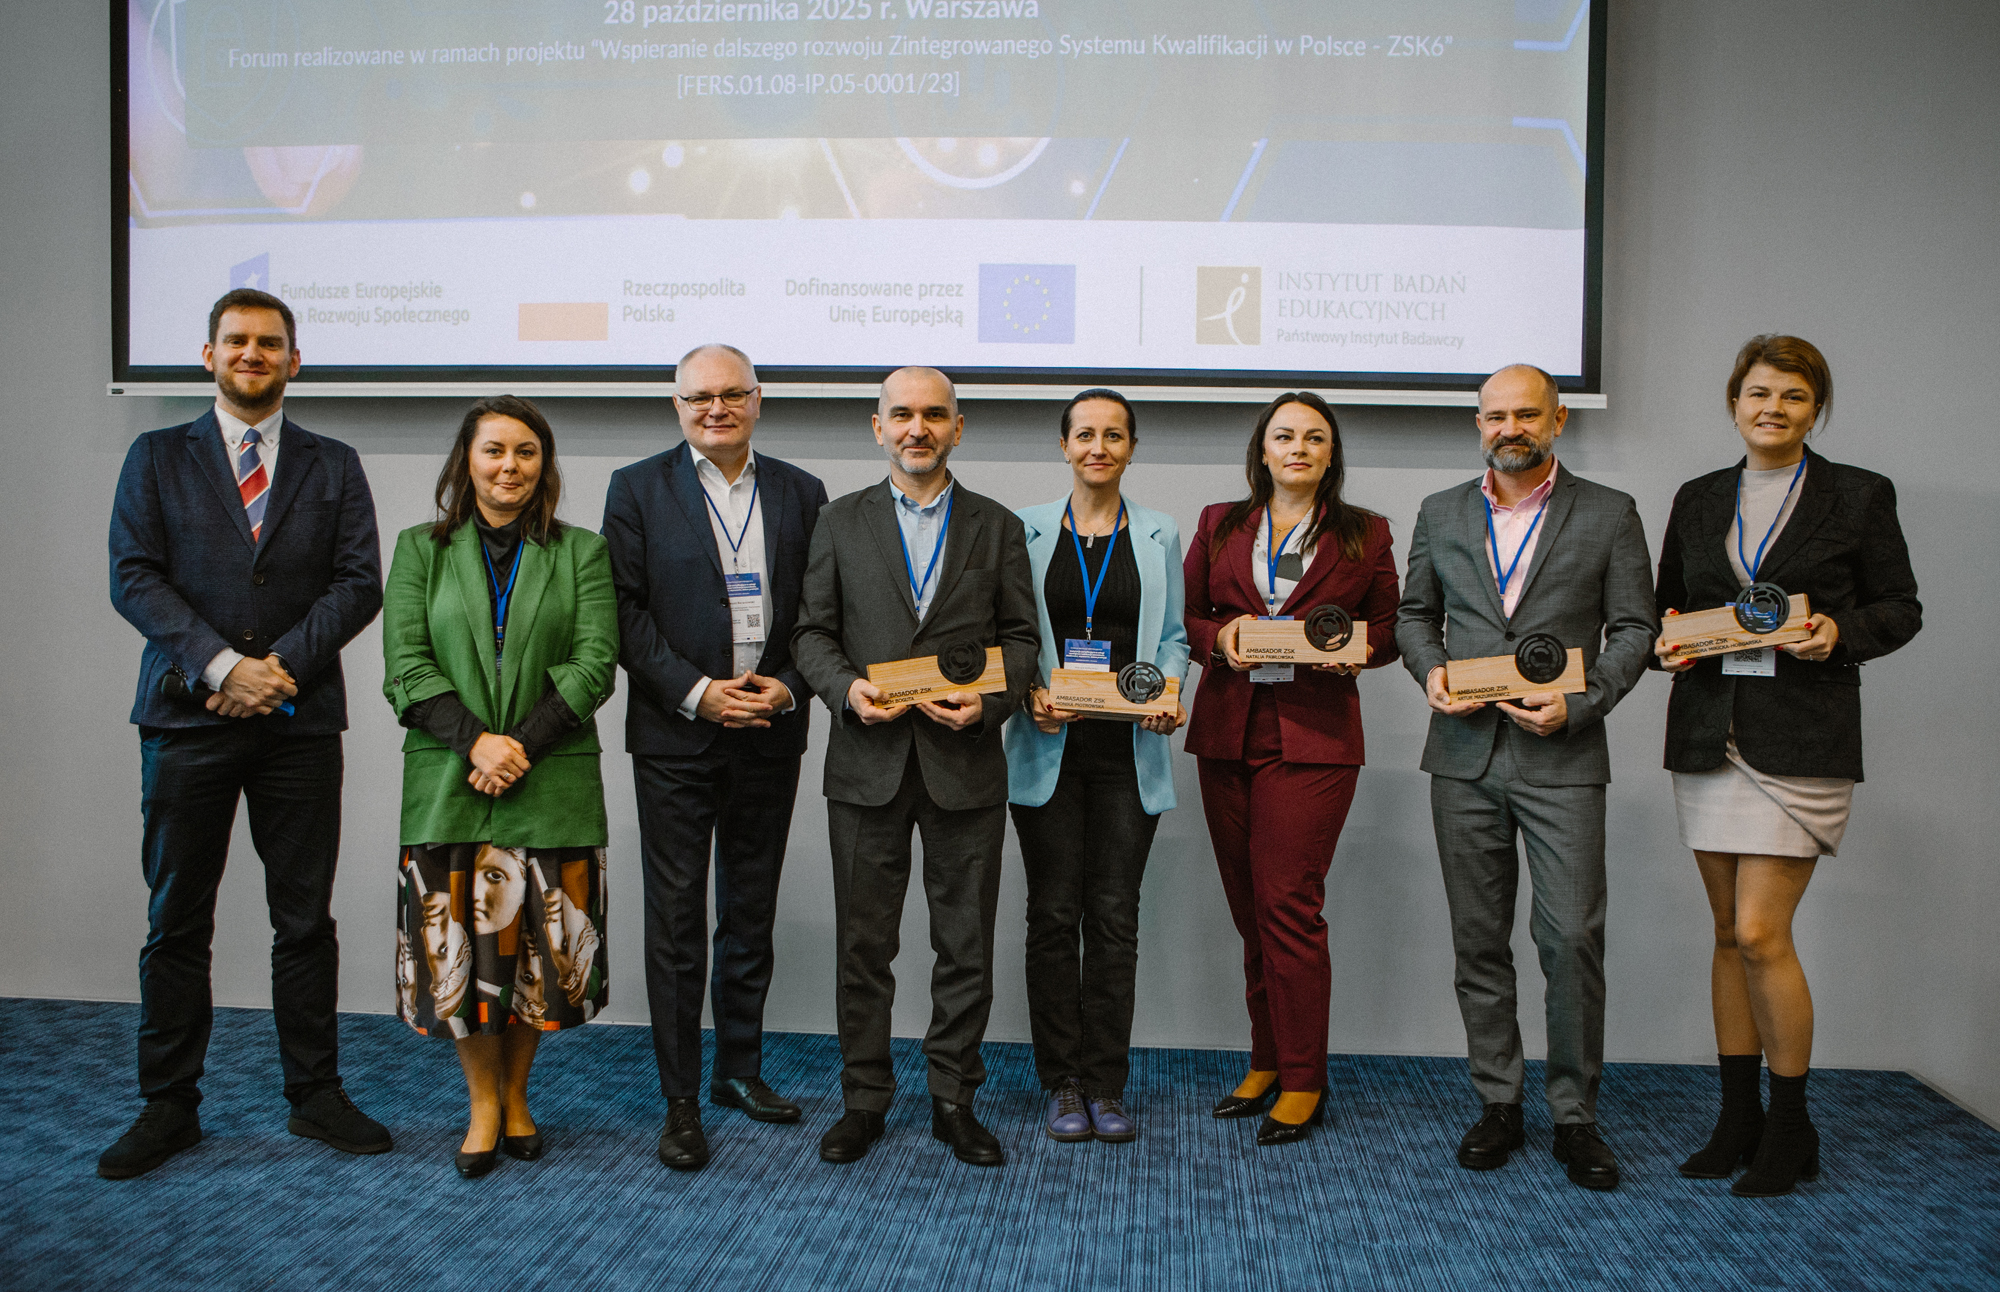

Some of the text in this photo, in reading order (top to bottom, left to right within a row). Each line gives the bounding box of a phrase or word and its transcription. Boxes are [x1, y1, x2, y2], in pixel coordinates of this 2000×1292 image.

[604, 0, 1040, 28] 28 października 2025 r. Warszawa
[228, 48, 288, 69] Forum
[293, 47, 404, 66] realizowane
[409, 48, 427, 64] w
[431, 42, 500, 64] ramach
[505, 40, 585, 66] projektu
[712, 37, 798, 61] dalszego
[803, 36, 883, 60] rozwoju
[888, 34, 1053, 59] Zintegrowanego
[1059, 34, 1146, 59] Systemu
[1153, 34, 1268, 60] Kwalifikacji
[1274, 39, 1294, 56] w
[1299, 35, 1367, 57] Polsce
[677, 71, 961, 99] [FERS.01.08-IP.05-0001/23]
[280, 281, 443, 302] Fundusze Europejskie
[623, 278, 745, 300] Rzeczpospolita
[784, 277, 964, 301] Dofinansowane przez
[1277, 270, 1467, 294] INSTYTUT BADAŃ
[307, 307, 370, 326] Rozwoju
[374, 305, 471, 326] Społecznego
[622, 304, 675, 323] Polska
[828, 304, 964, 328] Unię Europejską
[1277, 298, 1447, 323] EDUKACYJNYCH
[1276, 328, 1465, 350] Państwowy Instytut Badawczy
[1679, 640, 1714, 649] MBASADOR
[1457, 687, 1494, 695] AMBASADOR
